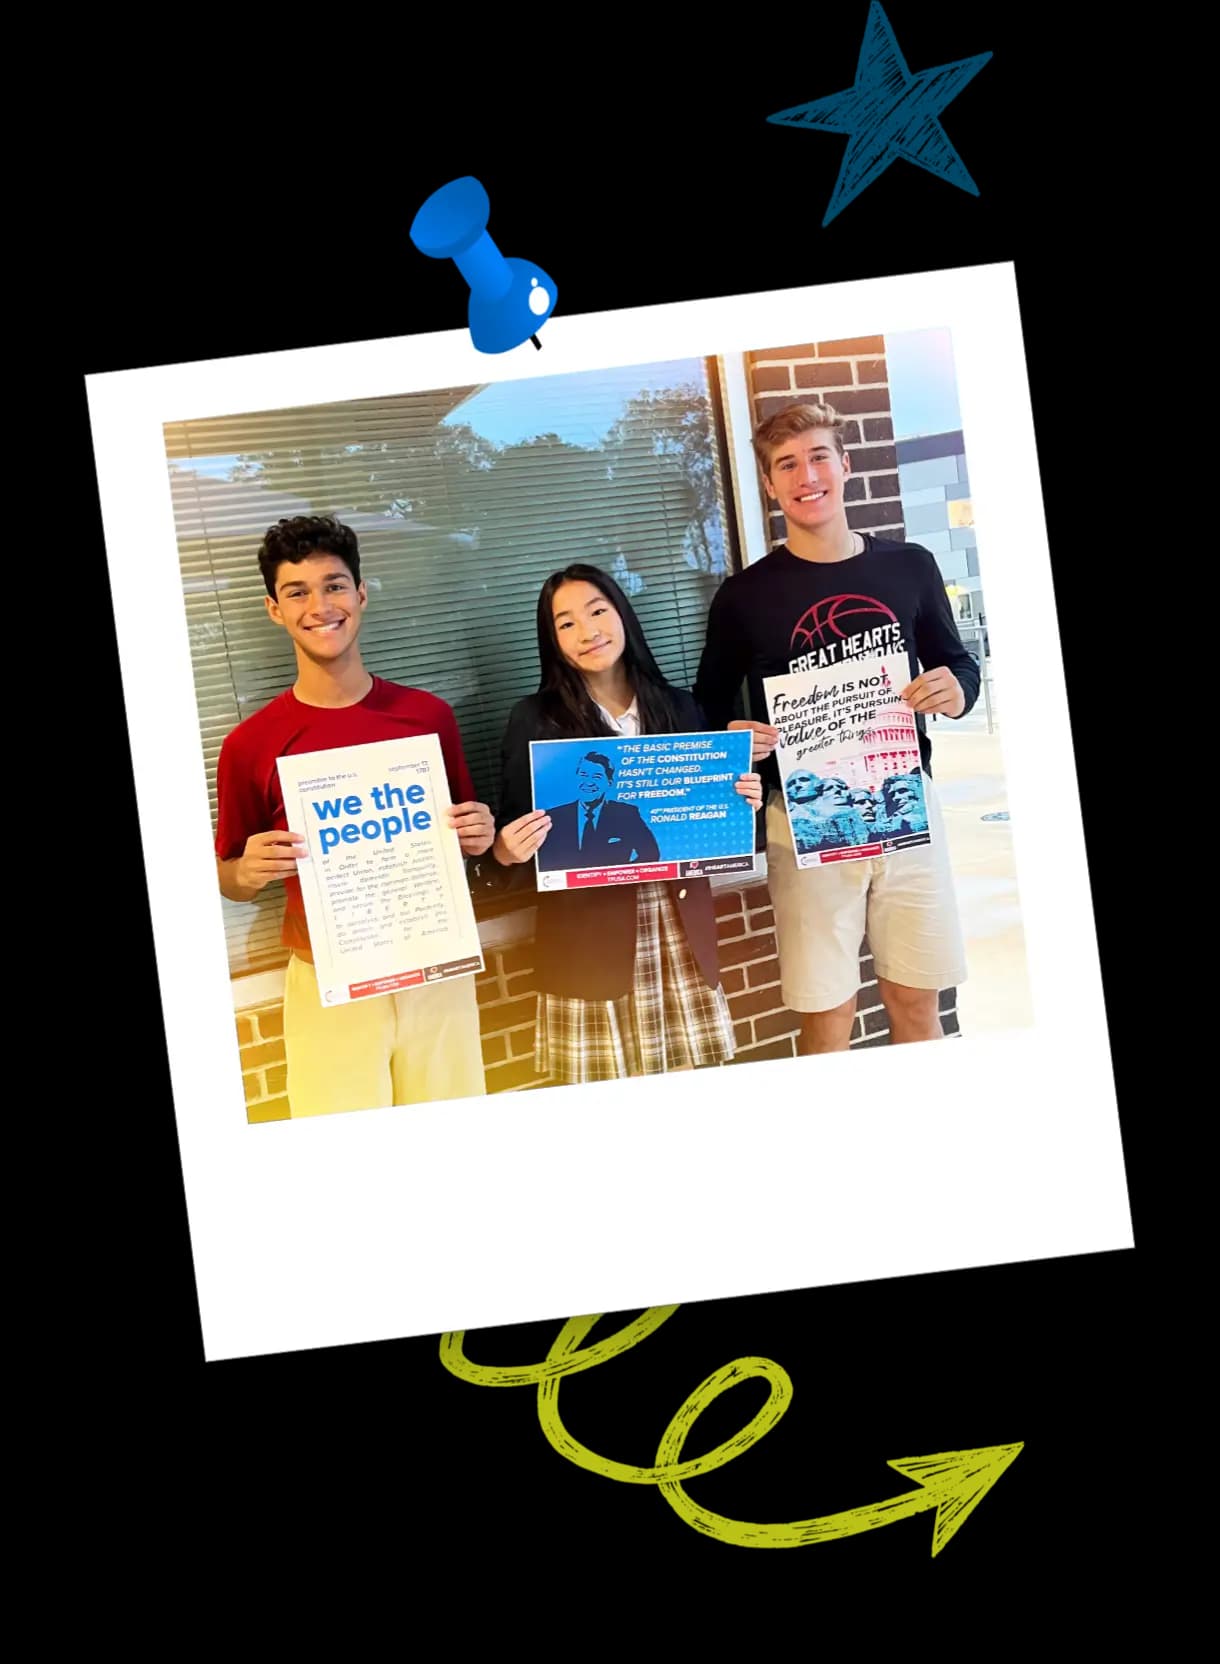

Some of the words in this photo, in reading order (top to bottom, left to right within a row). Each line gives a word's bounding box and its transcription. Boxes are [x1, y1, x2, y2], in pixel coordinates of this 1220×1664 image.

[788, 643, 837, 673] GREAT
[841, 621, 901, 658] HEARTS
[773, 685, 839, 714] Freedom
[842, 682, 855, 693] IS
[774, 709, 809, 725] ABOUT
[811, 702, 830, 714] THE
[832, 692, 875, 708] PURSUIT
[878, 687, 892, 696] OF
[833, 706, 851, 717] IT'S
[854, 695, 903, 710] PURSUIN
[780, 725, 826, 749] Value
[828, 720, 846, 731] OF
[849, 710, 877, 724] THE
[621, 757, 635, 765] OF
[638, 755, 656, 764] THE
[657, 751, 727, 763] CONSTITUTION
[643, 742, 671, 752] BASIC
[673, 741, 713, 750] PREMISE
[796, 736, 834, 761] greater
[616, 780, 633, 788] IT'S
[635, 779, 658, 787] STILL
[661, 777, 681, 786] OUR
[684, 773, 734, 785] BLUEPRINT
[618, 767, 653, 777] HASN'T
[312, 795, 362, 821] we
[370, 783, 425, 810] the
[617, 792, 637, 800] FOR
[650, 813, 687, 823] RONALD
[689, 811, 726, 820] REAGAN
[318, 807, 432, 854] people
